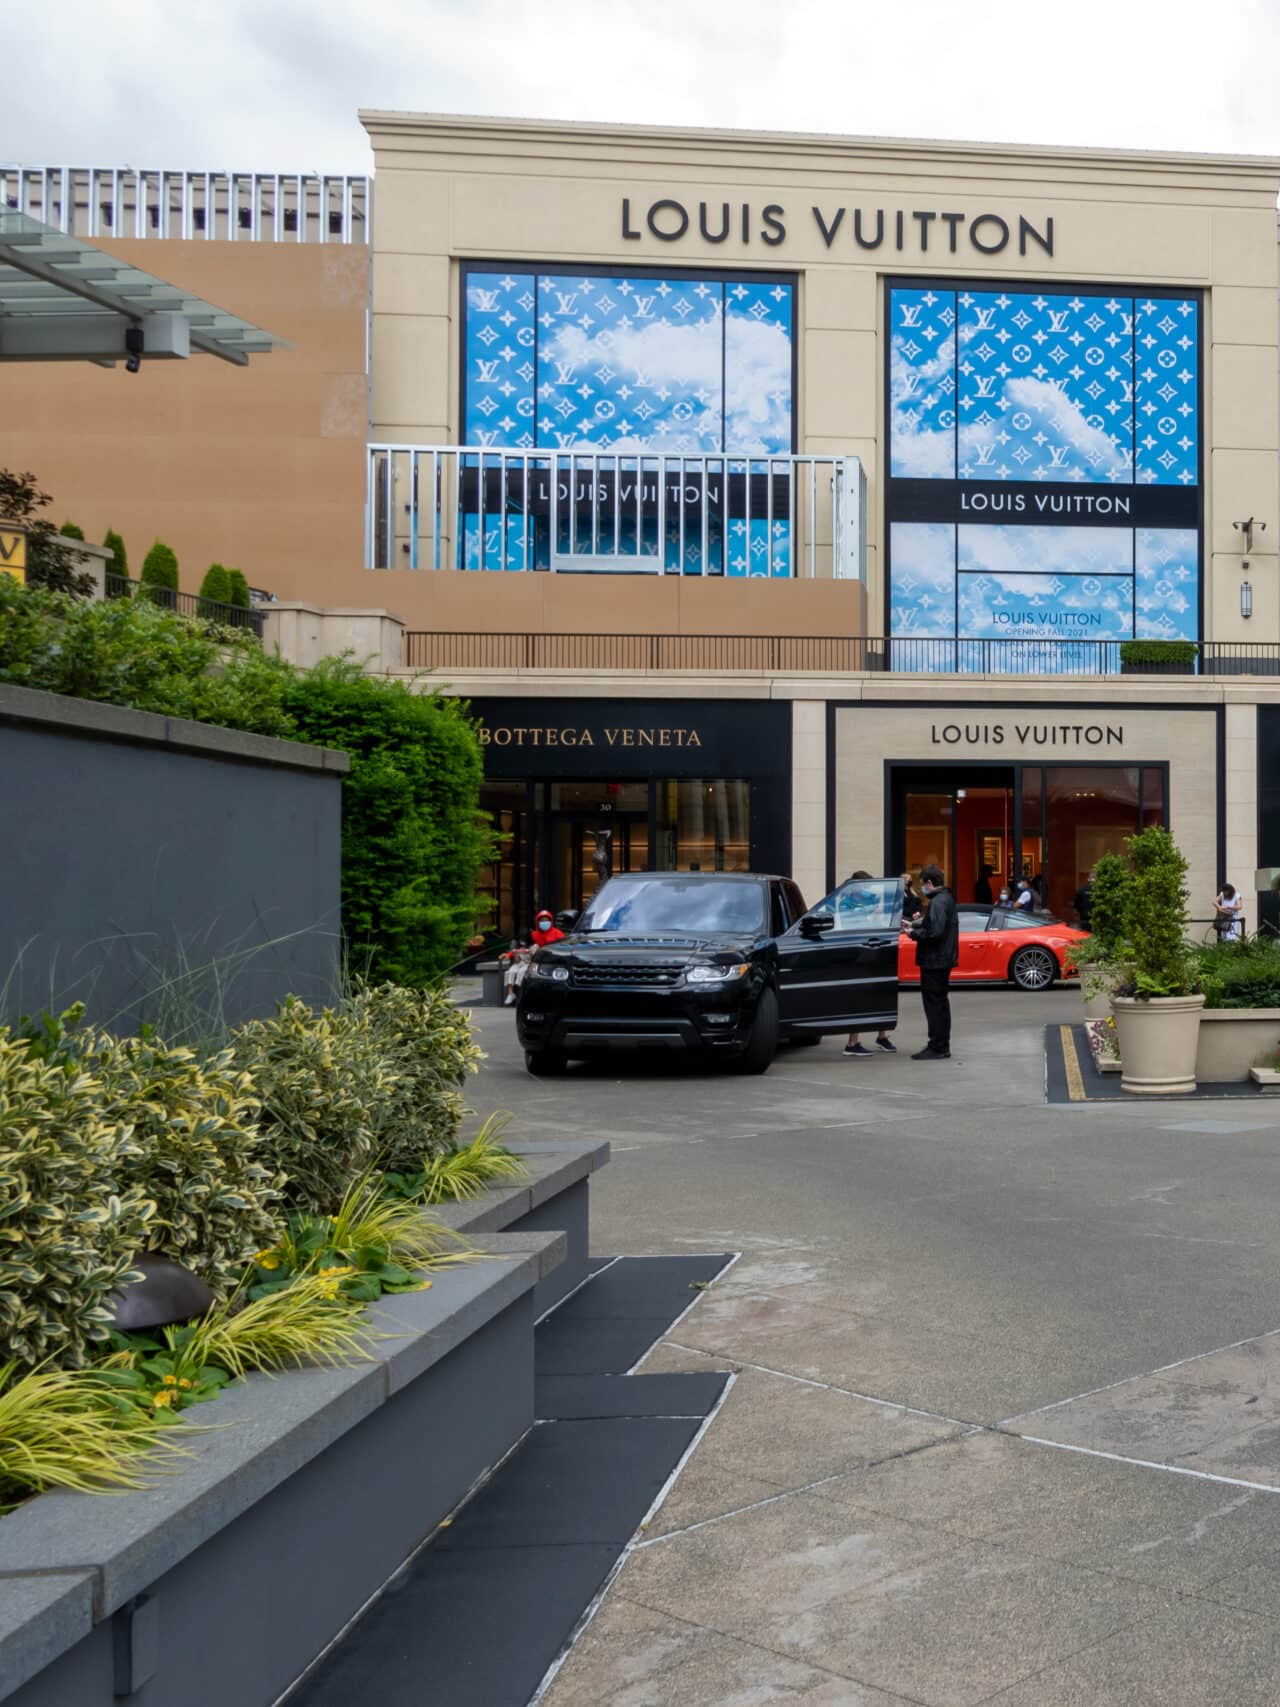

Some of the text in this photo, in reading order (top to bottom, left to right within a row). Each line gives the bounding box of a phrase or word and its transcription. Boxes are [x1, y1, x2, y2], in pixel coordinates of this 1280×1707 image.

[621, 197, 1055, 258] LOUIS VUITTON
[618, 484, 719, 504] VUITON
[961, 492, 1131, 514] LOUIS VUITTON
[992, 611, 1101, 626] LOUIS VUITTON
[1005, 627, 1046, 637] OPENING
[1068, 628, 1088, 637] 2021
[478, 728, 702, 747] BOTTEGA VENETA
[931, 724, 1124, 745] LOUIS VUITTON
